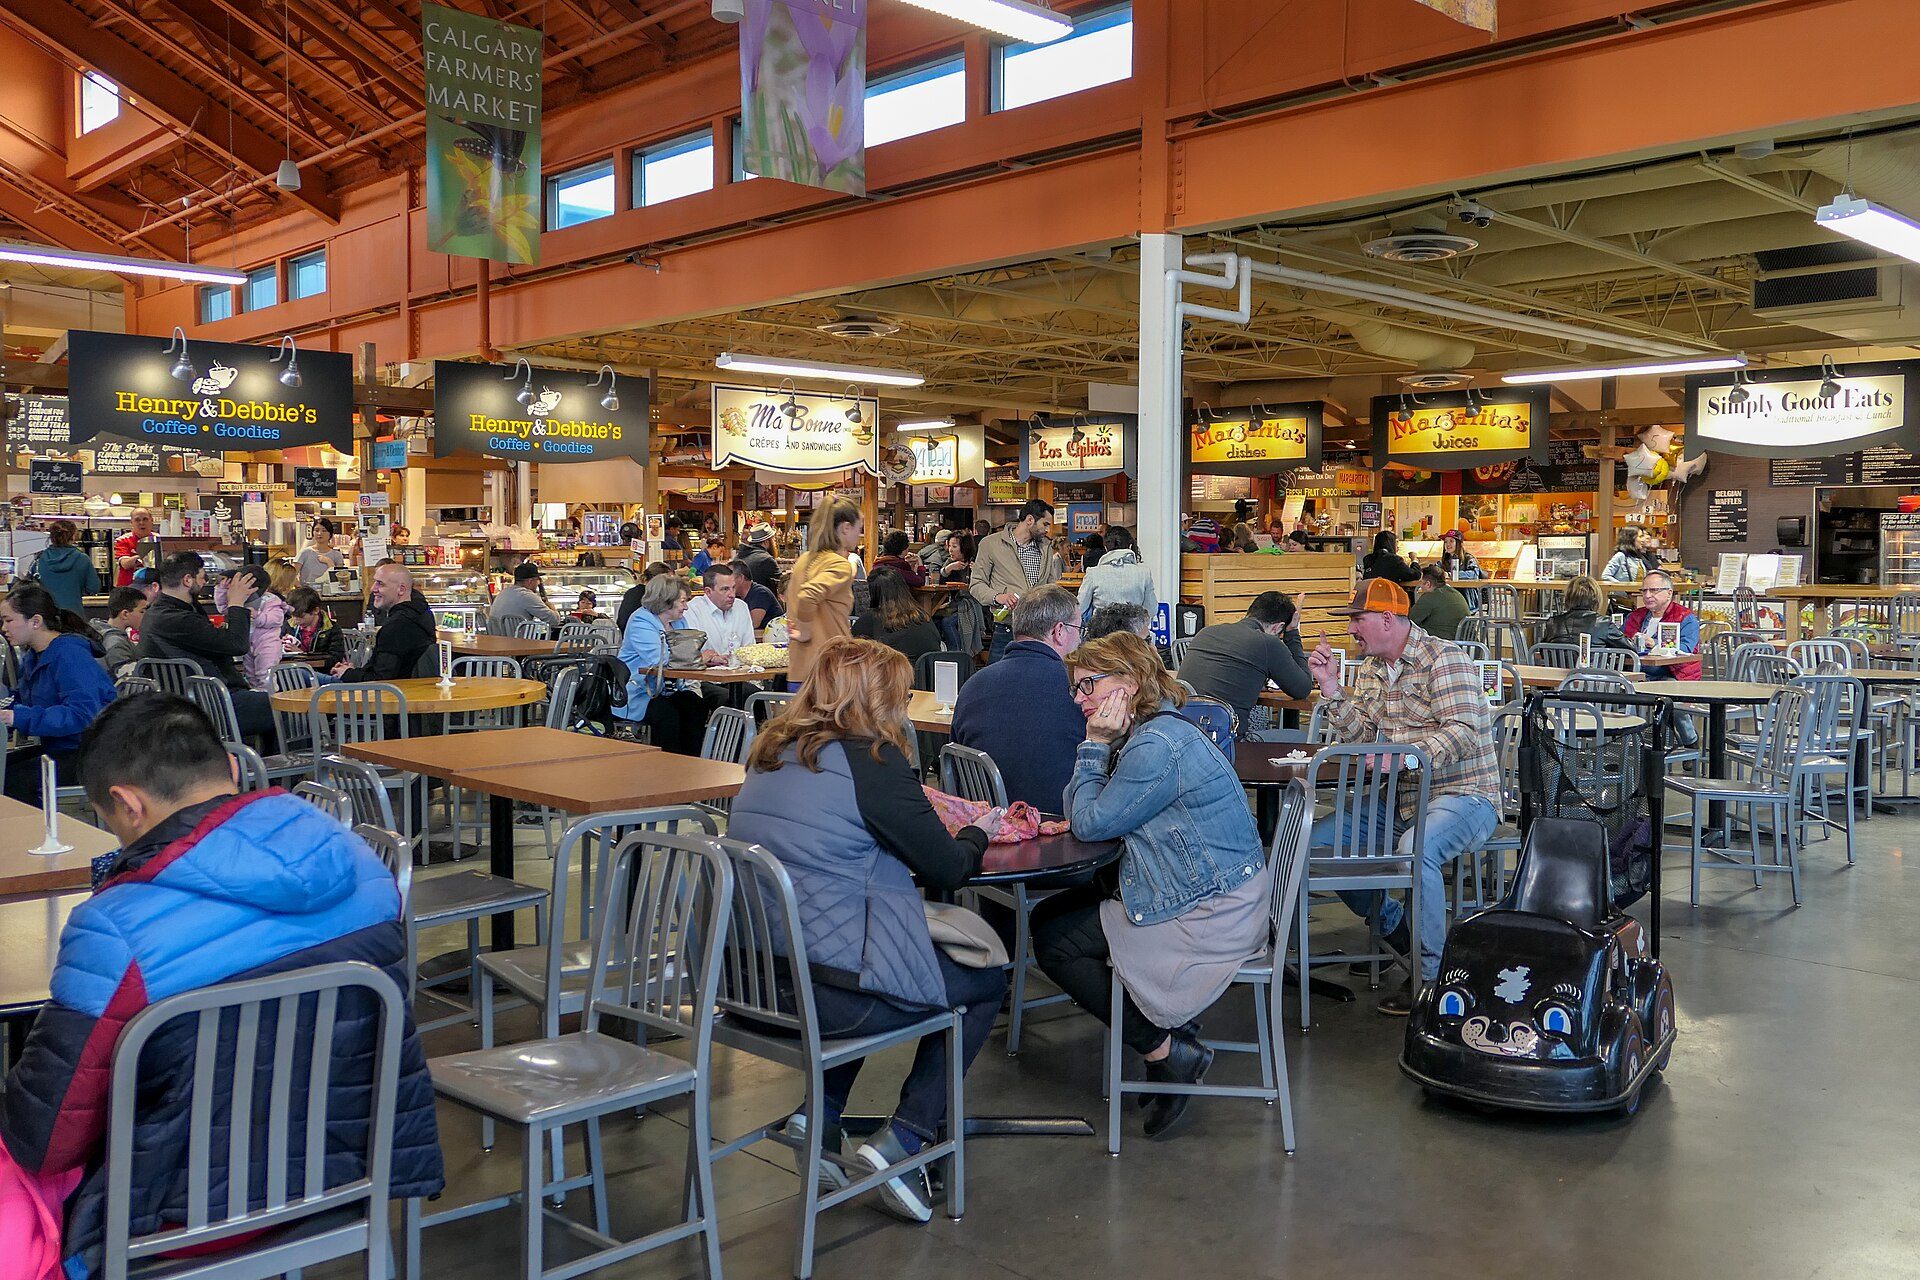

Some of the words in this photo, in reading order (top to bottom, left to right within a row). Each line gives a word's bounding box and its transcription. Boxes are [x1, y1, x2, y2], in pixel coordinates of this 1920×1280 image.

[426, 22, 537, 64] CALGARY
[426, 51, 540, 92] FARMERS'
[428, 83, 537, 124] MARKET
[1707, 395, 1774, 419] Simply
[1781, 391, 1835, 412] Good
[1844, 388, 1893, 408] Eats
[748, 403, 783, 430] Ma
[790, 404, 842, 434] Bonne
[1389, 408, 1530, 440] Margarita's
[1866, 408, 1893, 421] Lunch
[142, 418, 198, 435] Coffee
[213, 421, 281, 440] Goodies
[489, 436, 531, 450] Coffee
[543, 440, 594, 454] Goodies
[801, 441, 842, 452] SANDWICHES
[1039, 440, 1063, 459] Los
[1432, 432, 1479, 449] Juices
[1226, 443, 1267, 459] dishes
[914, 468, 952, 476] PIZZA
[1304, 486, 1320, 497] FRUIT
[1321, 487, 1352, 497] SMOOHIES
